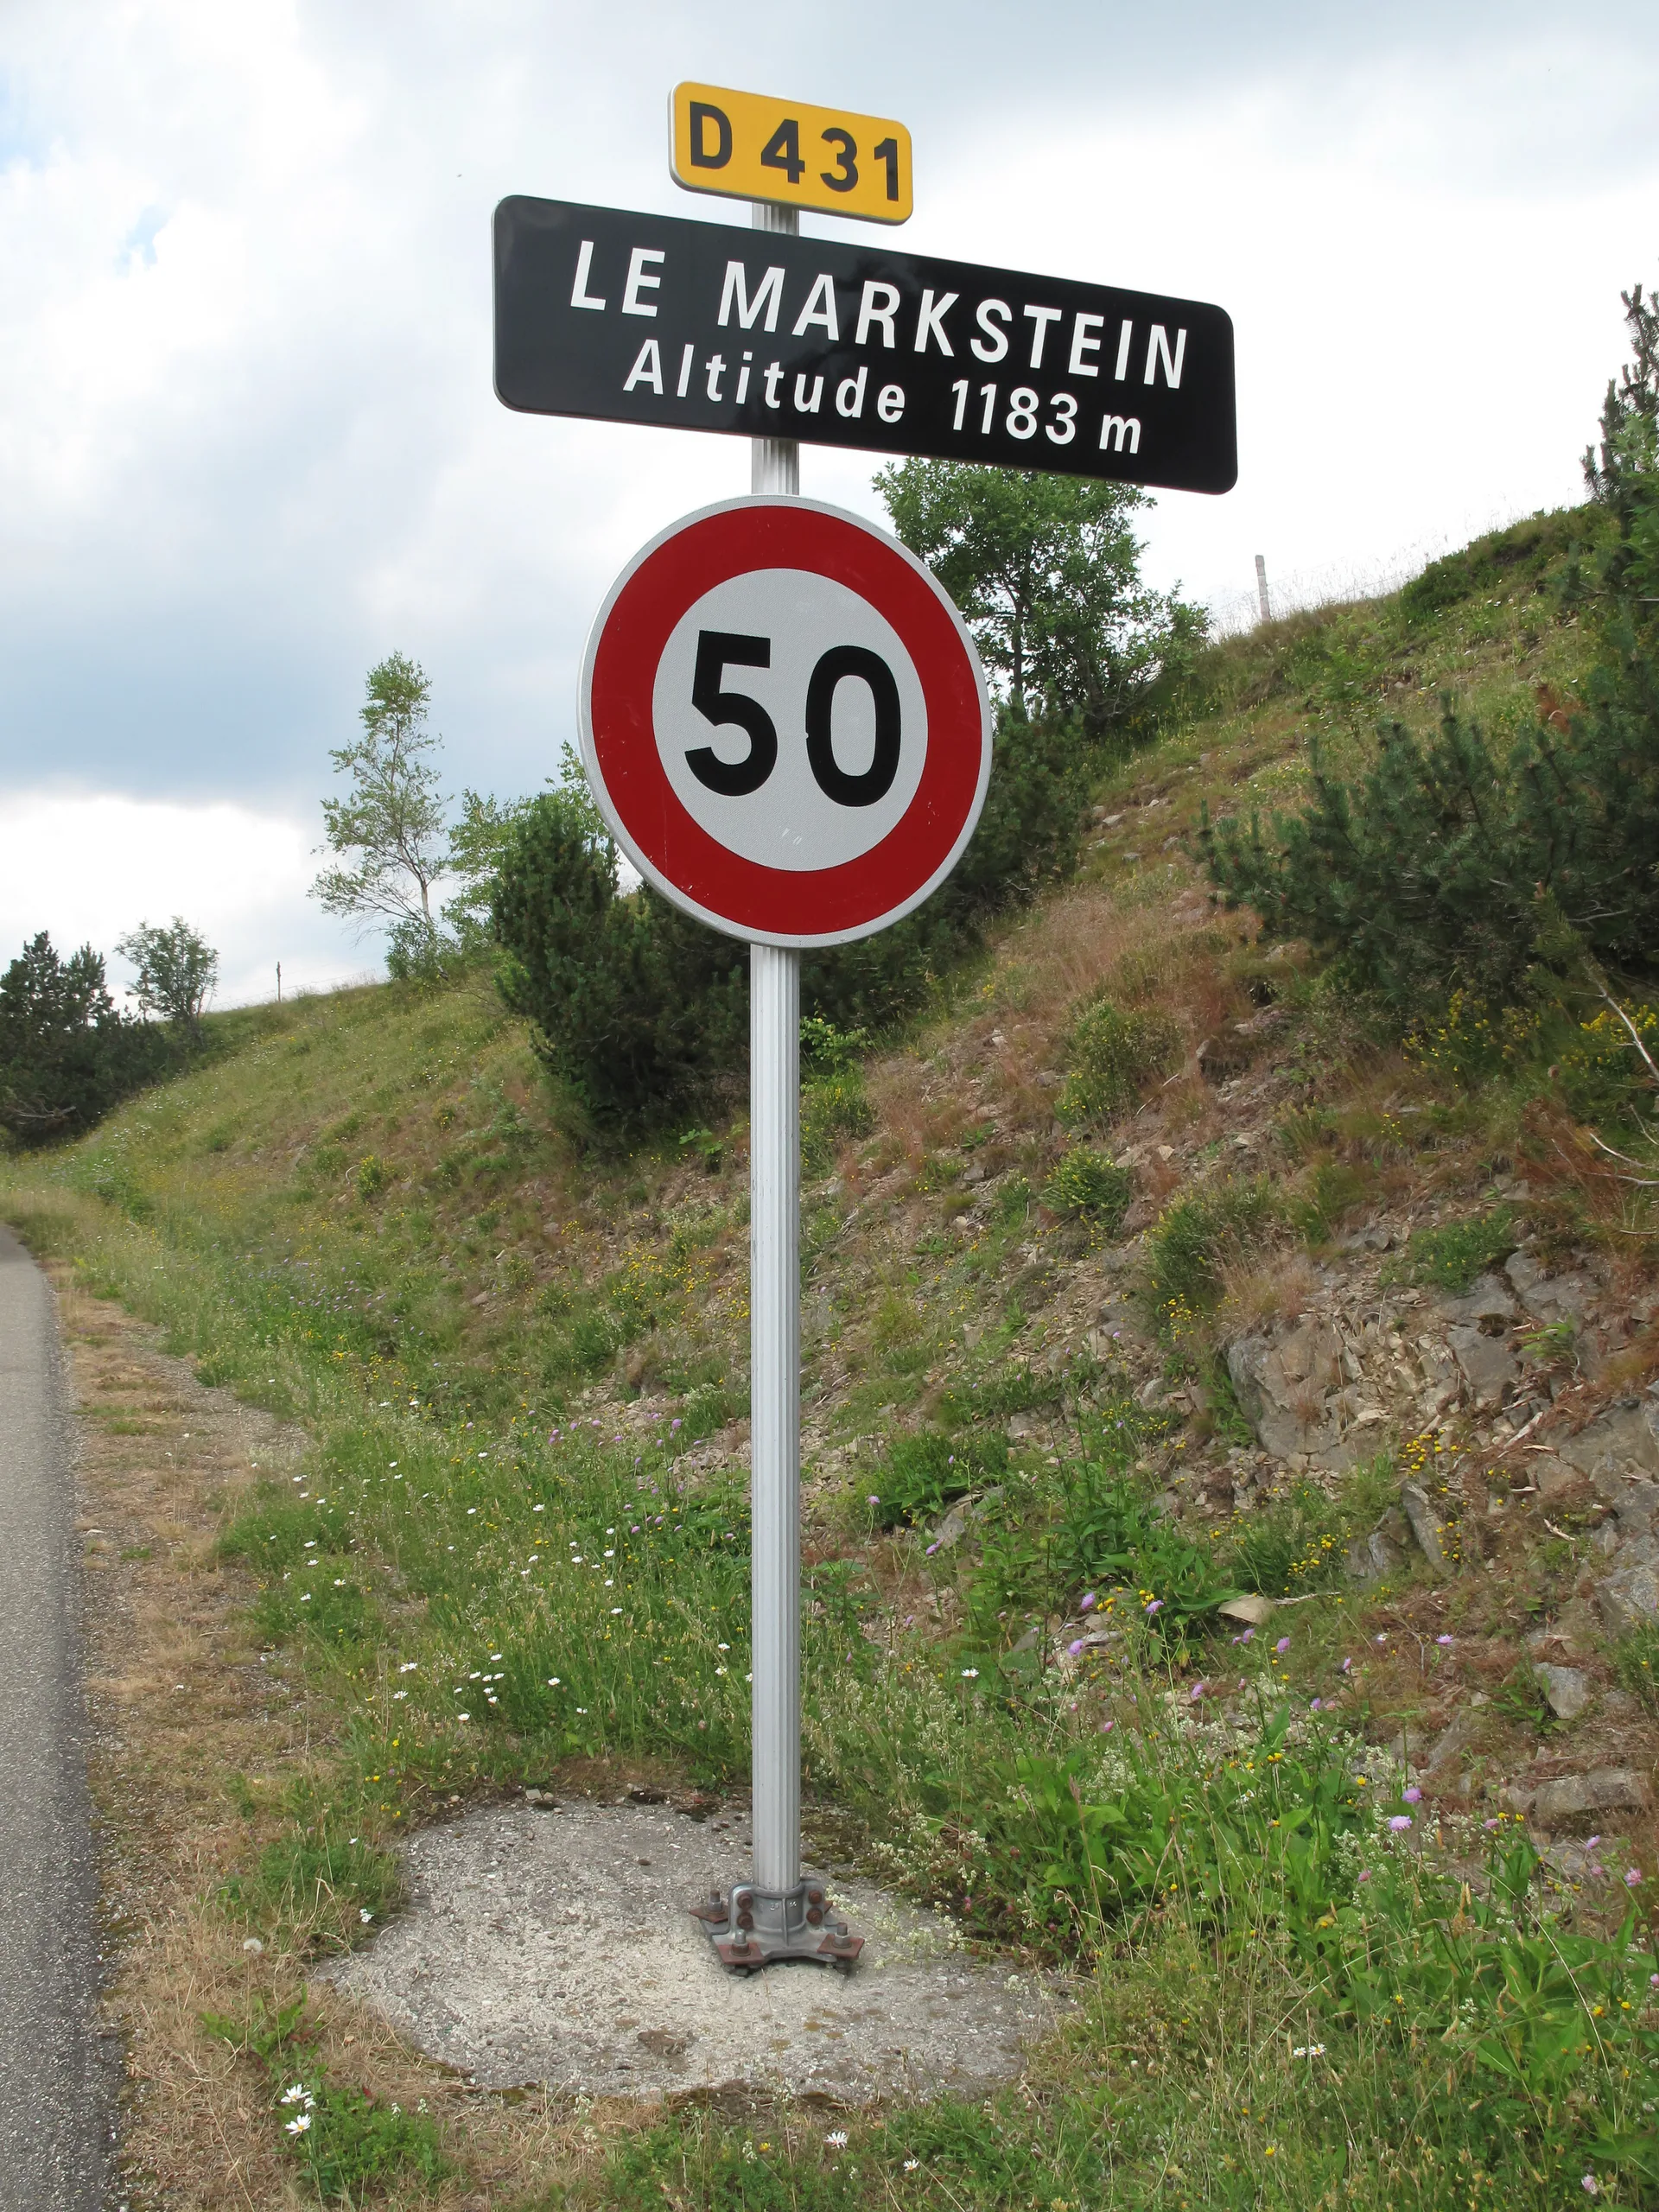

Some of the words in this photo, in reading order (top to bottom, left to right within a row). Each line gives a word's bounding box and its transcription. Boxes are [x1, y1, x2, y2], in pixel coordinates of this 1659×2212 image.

[690, 101, 733, 168] D
[760, 118, 899, 201] 431
[569, 239, 666, 318] LE
[717, 260, 1187, 390] MARKSTEIN
[622, 339, 906, 423] Altitude
[951, 379, 1078, 445] 1183
[1098, 414, 1141, 454] m
[683, 629, 902, 808] 50
